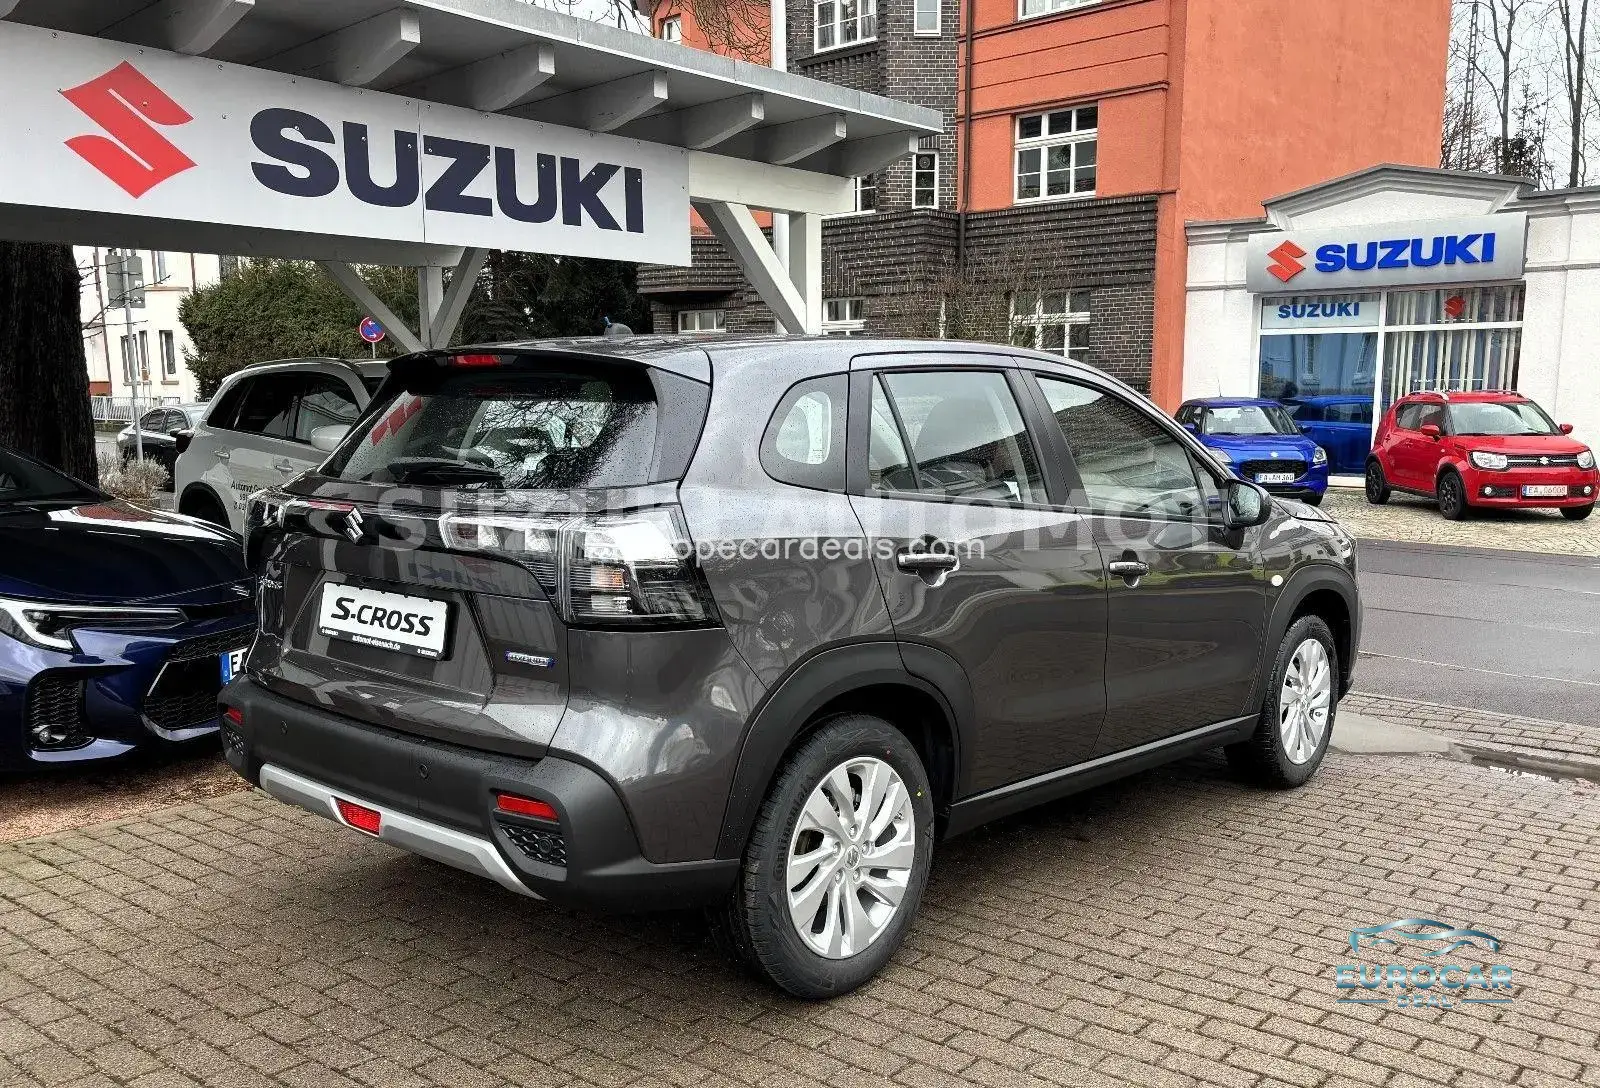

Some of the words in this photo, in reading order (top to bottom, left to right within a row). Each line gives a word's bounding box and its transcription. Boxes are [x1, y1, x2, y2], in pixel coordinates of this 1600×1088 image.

[250, 107, 644, 233] SUZUKI
[1315, 233, 1495, 272] SUZUKI
[1278, 301, 1360, 319] SUZUKI
[330, 597, 434, 636] S-CROSS
